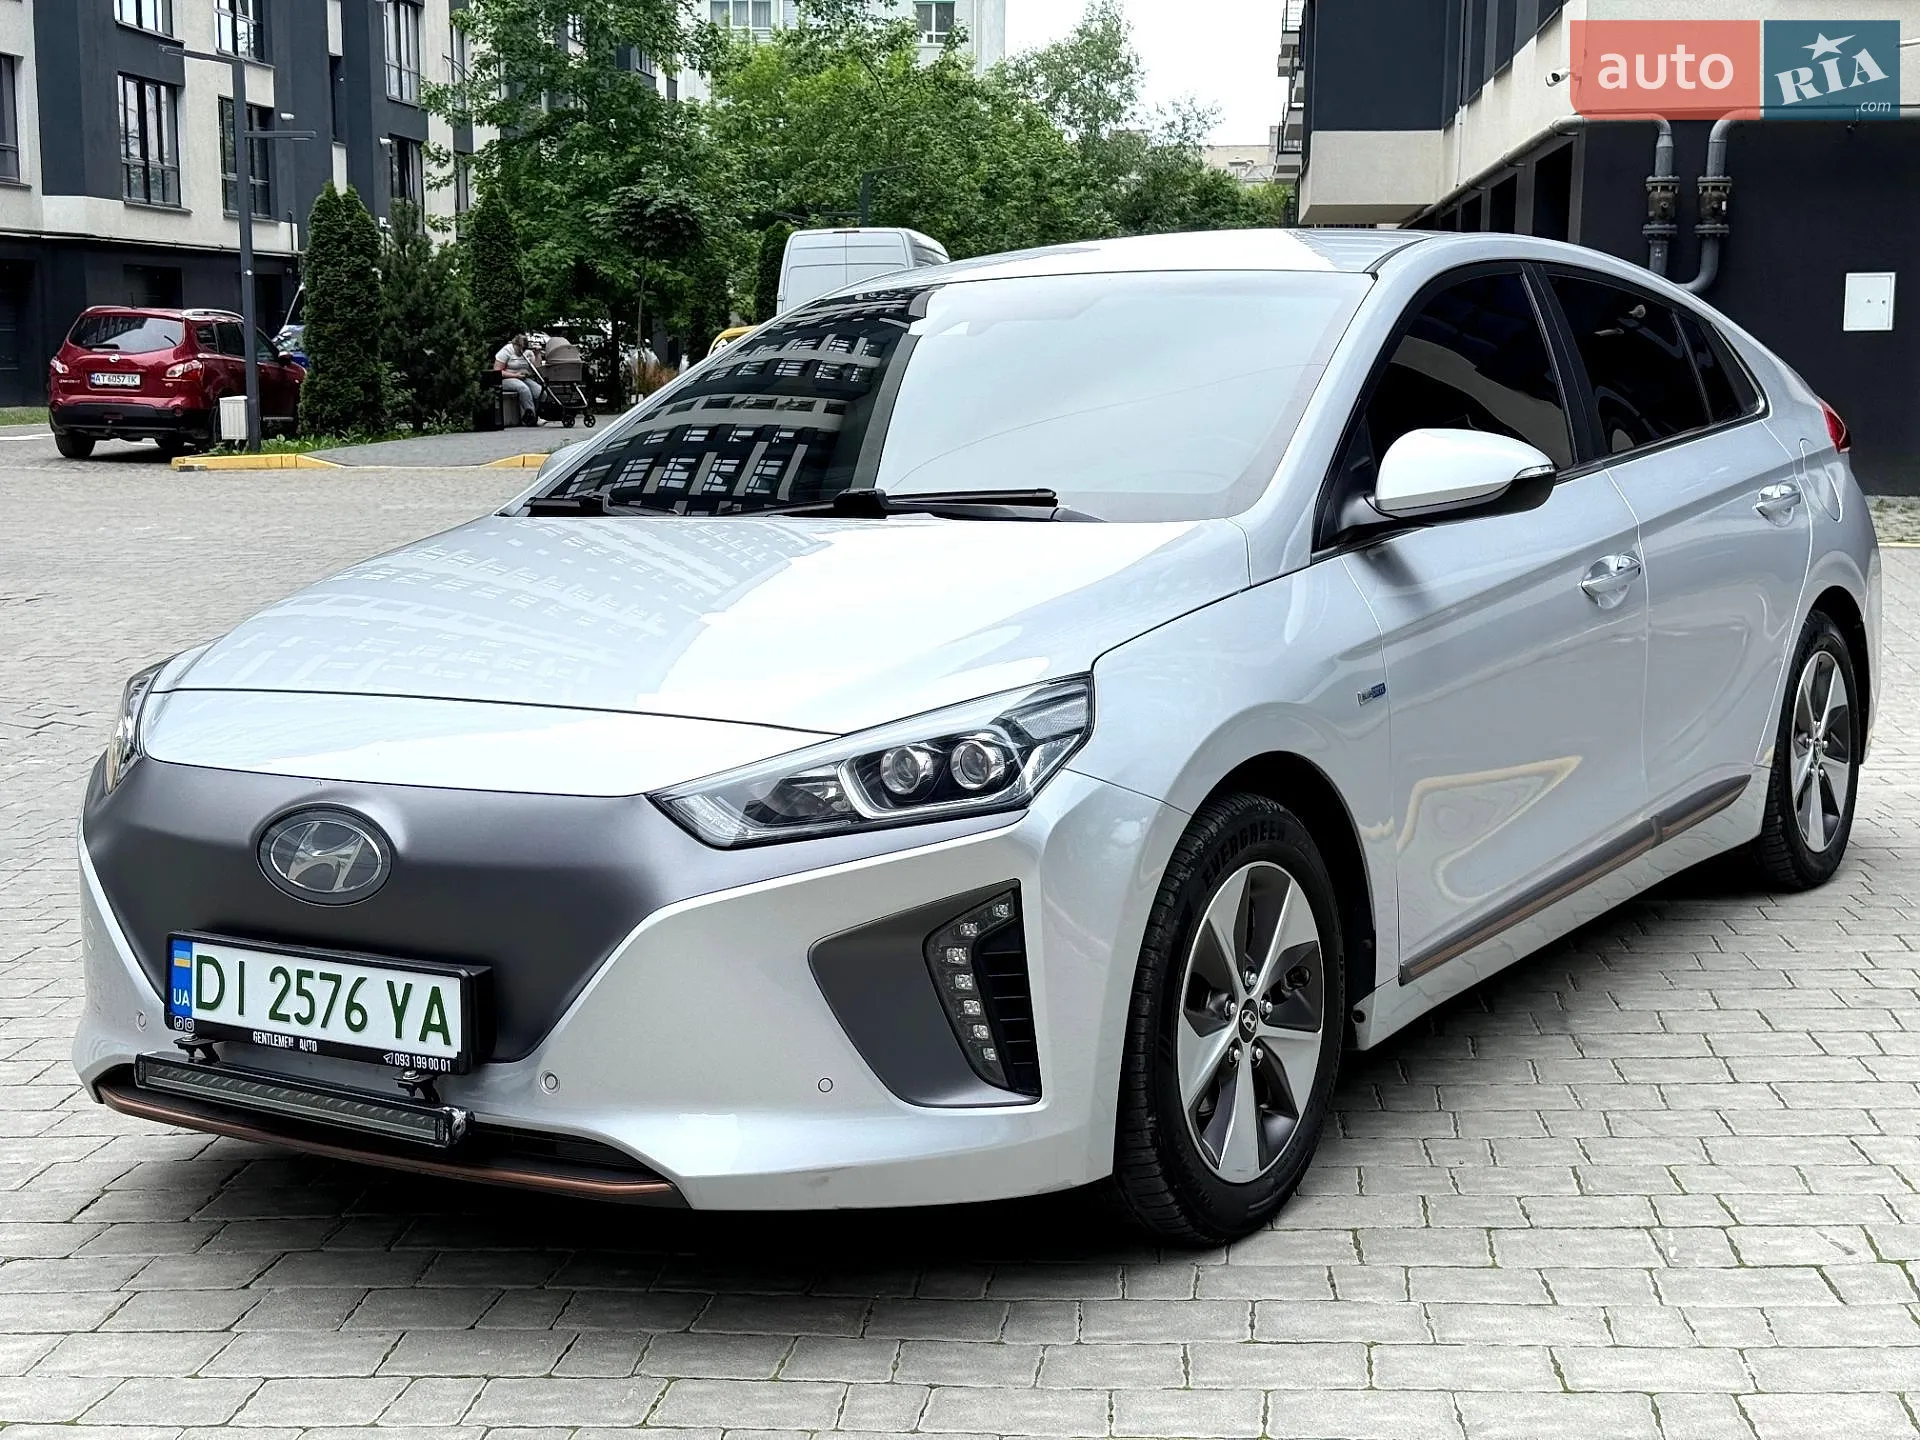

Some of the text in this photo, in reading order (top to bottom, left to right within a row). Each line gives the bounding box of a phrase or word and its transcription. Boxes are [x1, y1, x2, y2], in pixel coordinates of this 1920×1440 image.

[96, 374, 106, 383] AT
[173, 987, 190, 1007] UA
[196, 954, 452, 1046] DI 2576 YA
[299, 1037, 318, 1053] AUTO
[394, 1052, 451, 1073] 093 199 00 01
